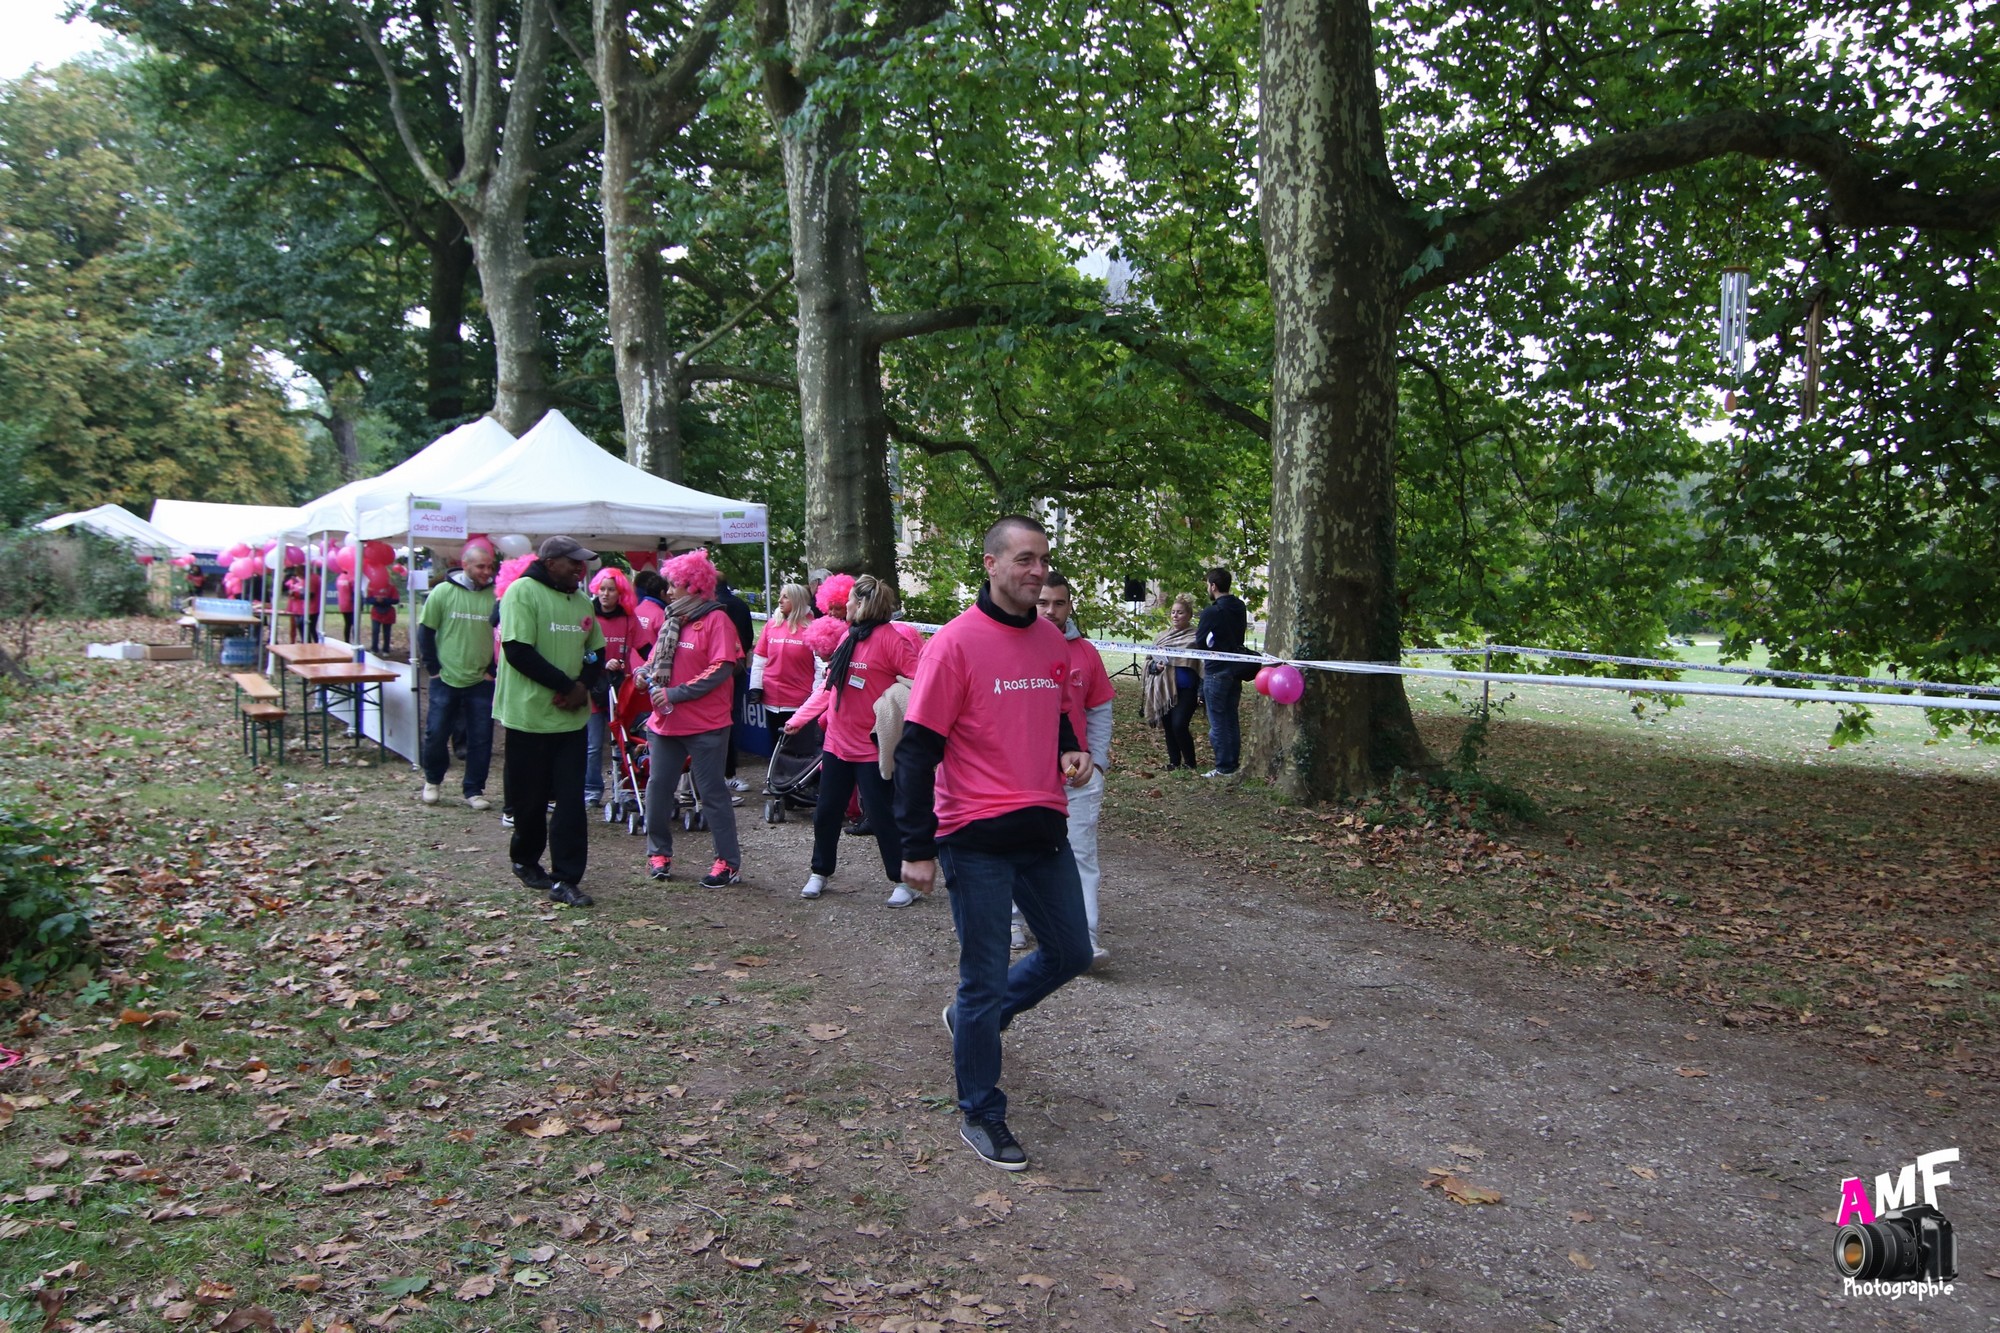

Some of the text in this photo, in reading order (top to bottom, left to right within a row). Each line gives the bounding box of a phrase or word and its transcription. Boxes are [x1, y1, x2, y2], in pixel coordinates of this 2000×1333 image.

[421, 513, 457, 522] Accueil
[413, 523, 430, 531] des
[730, 520, 758, 529] Accueil
[723, 530, 766, 539] inscriptions
[1003, 679, 1029, 691] ROSE
[742, 694, 767, 728] leu
